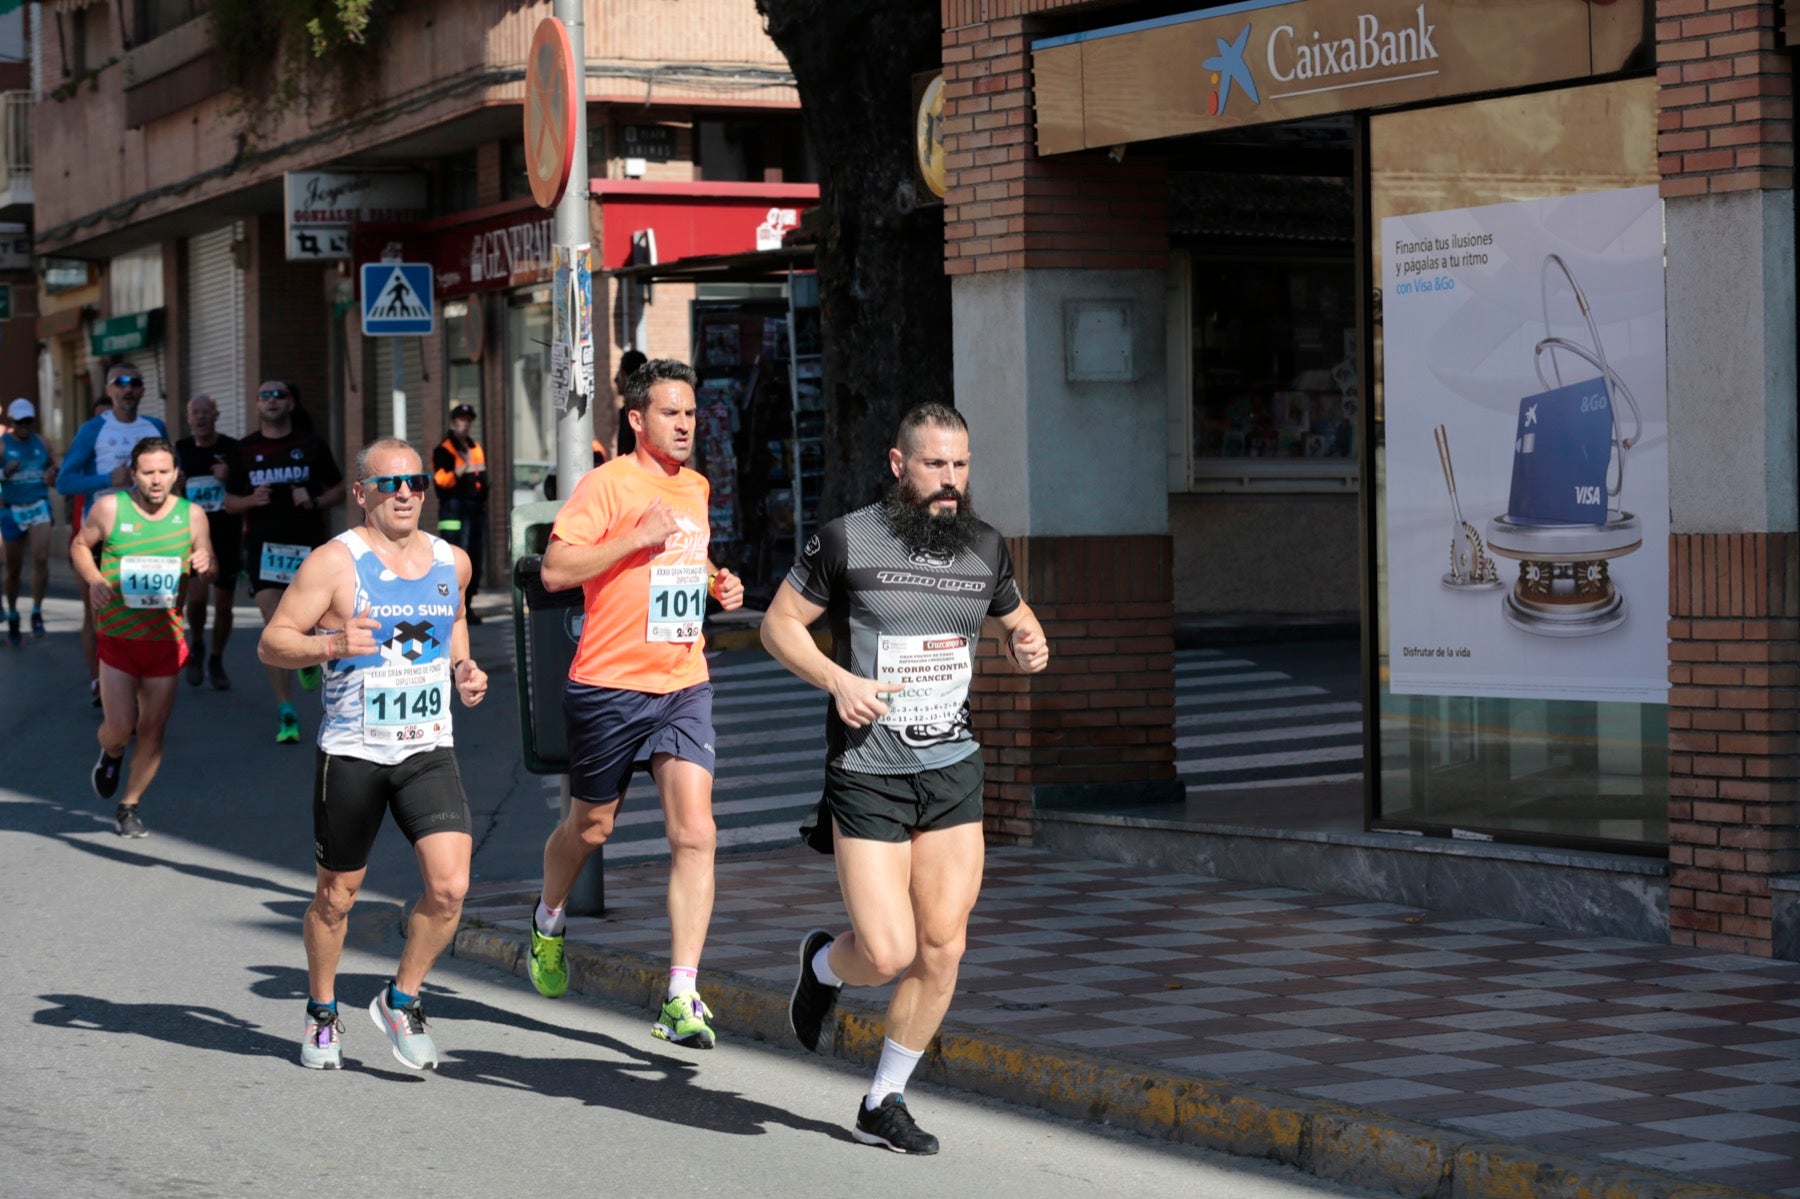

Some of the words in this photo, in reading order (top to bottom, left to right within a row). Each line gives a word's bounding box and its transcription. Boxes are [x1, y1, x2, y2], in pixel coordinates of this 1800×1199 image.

[1267, 3, 1439, 82] CaixaBank
[1395, 237, 1433, 255] Financia
[1435, 238, 1450, 251] tus
[1452, 233, 1493, 249] ilusiones
[1396, 262, 1402, 277] y
[1404, 256, 1439, 276] págalas
[1441, 258, 1447, 269] a
[1450, 255, 1460, 268] tu
[1462, 252, 1488, 266] ritmo
[1396, 282, 1412, 295] con
[1414, 279, 1432, 292] Visa
[1434, 276, 1455, 291] &Go
[1581, 393, 1607, 413] &Go
[1575, 486, 1601, 505] VISA
[129, 573, 174, 590] 1190
[371, 604, 414, 617] TODO
[418, 604, 454, 617] SUMA
[655, 588, 706, 618] 101
[1403, 646, 1434, 657] Disfrutar
[1436, 646, 1445, 657] de
[1447, 647, 1453, 657] la
[1455, 647, 1471, 657] vida
[388, 669, 402, 677] GRAN
[882, 666, 894, 674] YO
[897, 665, 931, 673] CORRO
[933, 662, 968, 672] CONTRA
[916, 674, 953, 683] CANCER
[898, 688, 932, 698] aecc
[372, 687, 441, 720] 1149
